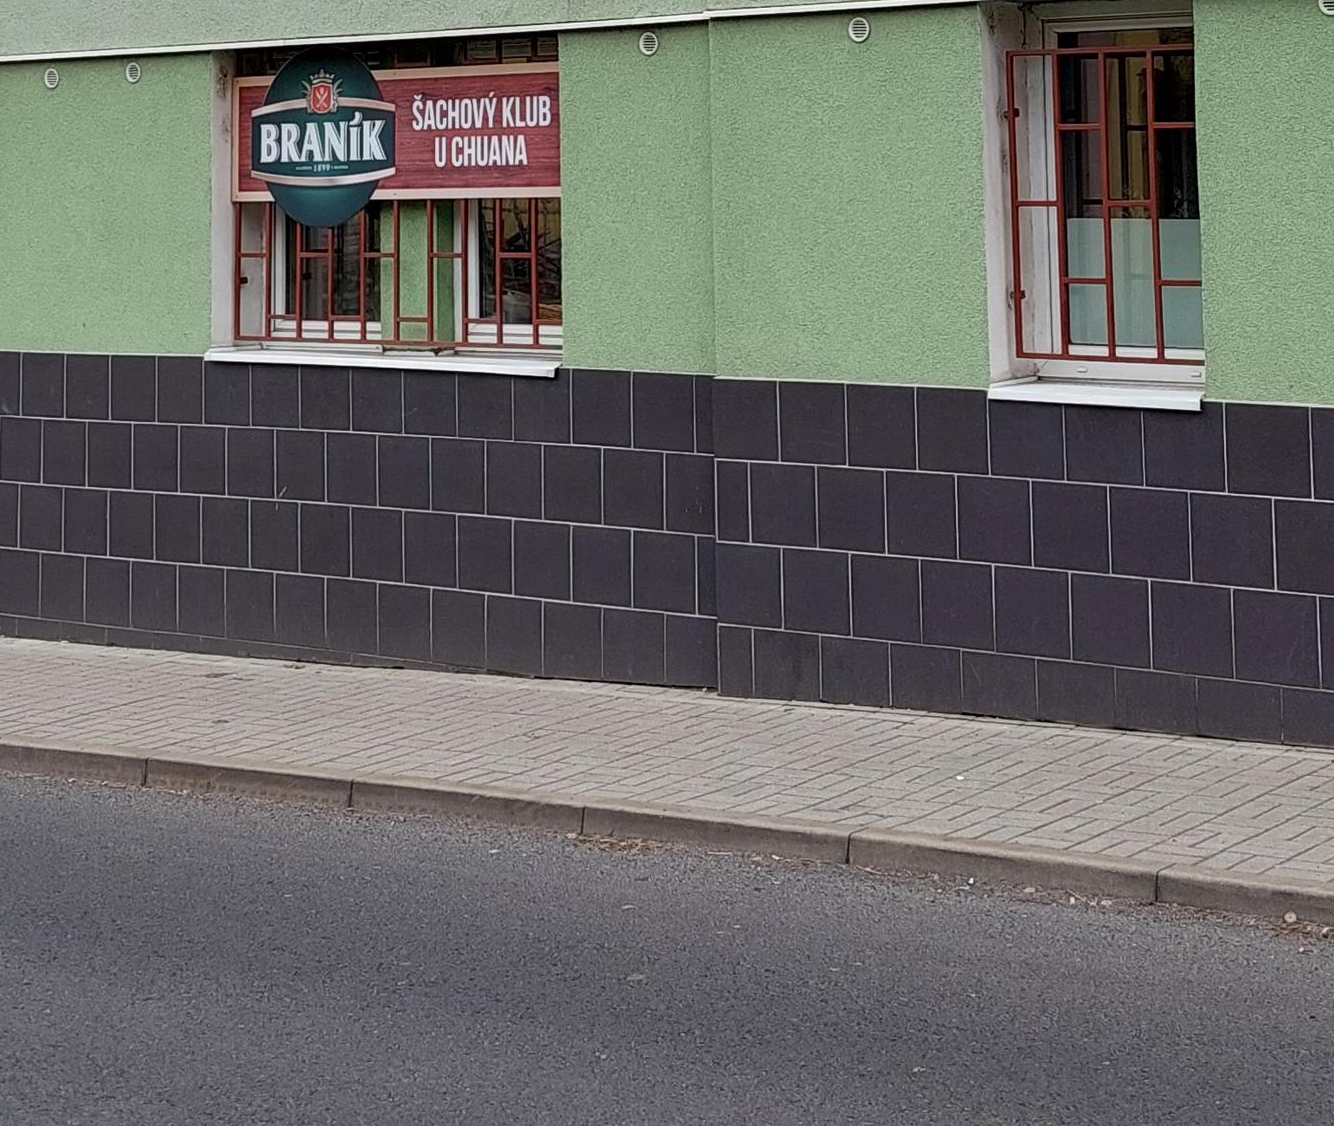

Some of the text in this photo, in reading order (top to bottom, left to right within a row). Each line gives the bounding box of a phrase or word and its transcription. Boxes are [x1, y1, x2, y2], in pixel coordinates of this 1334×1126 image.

[412, 91, 552, 130] ŠACHOVÝ KLUB
[259, 111, 386, 163] BRANÍK
[434, 135, 528, 168] U CHUANA
